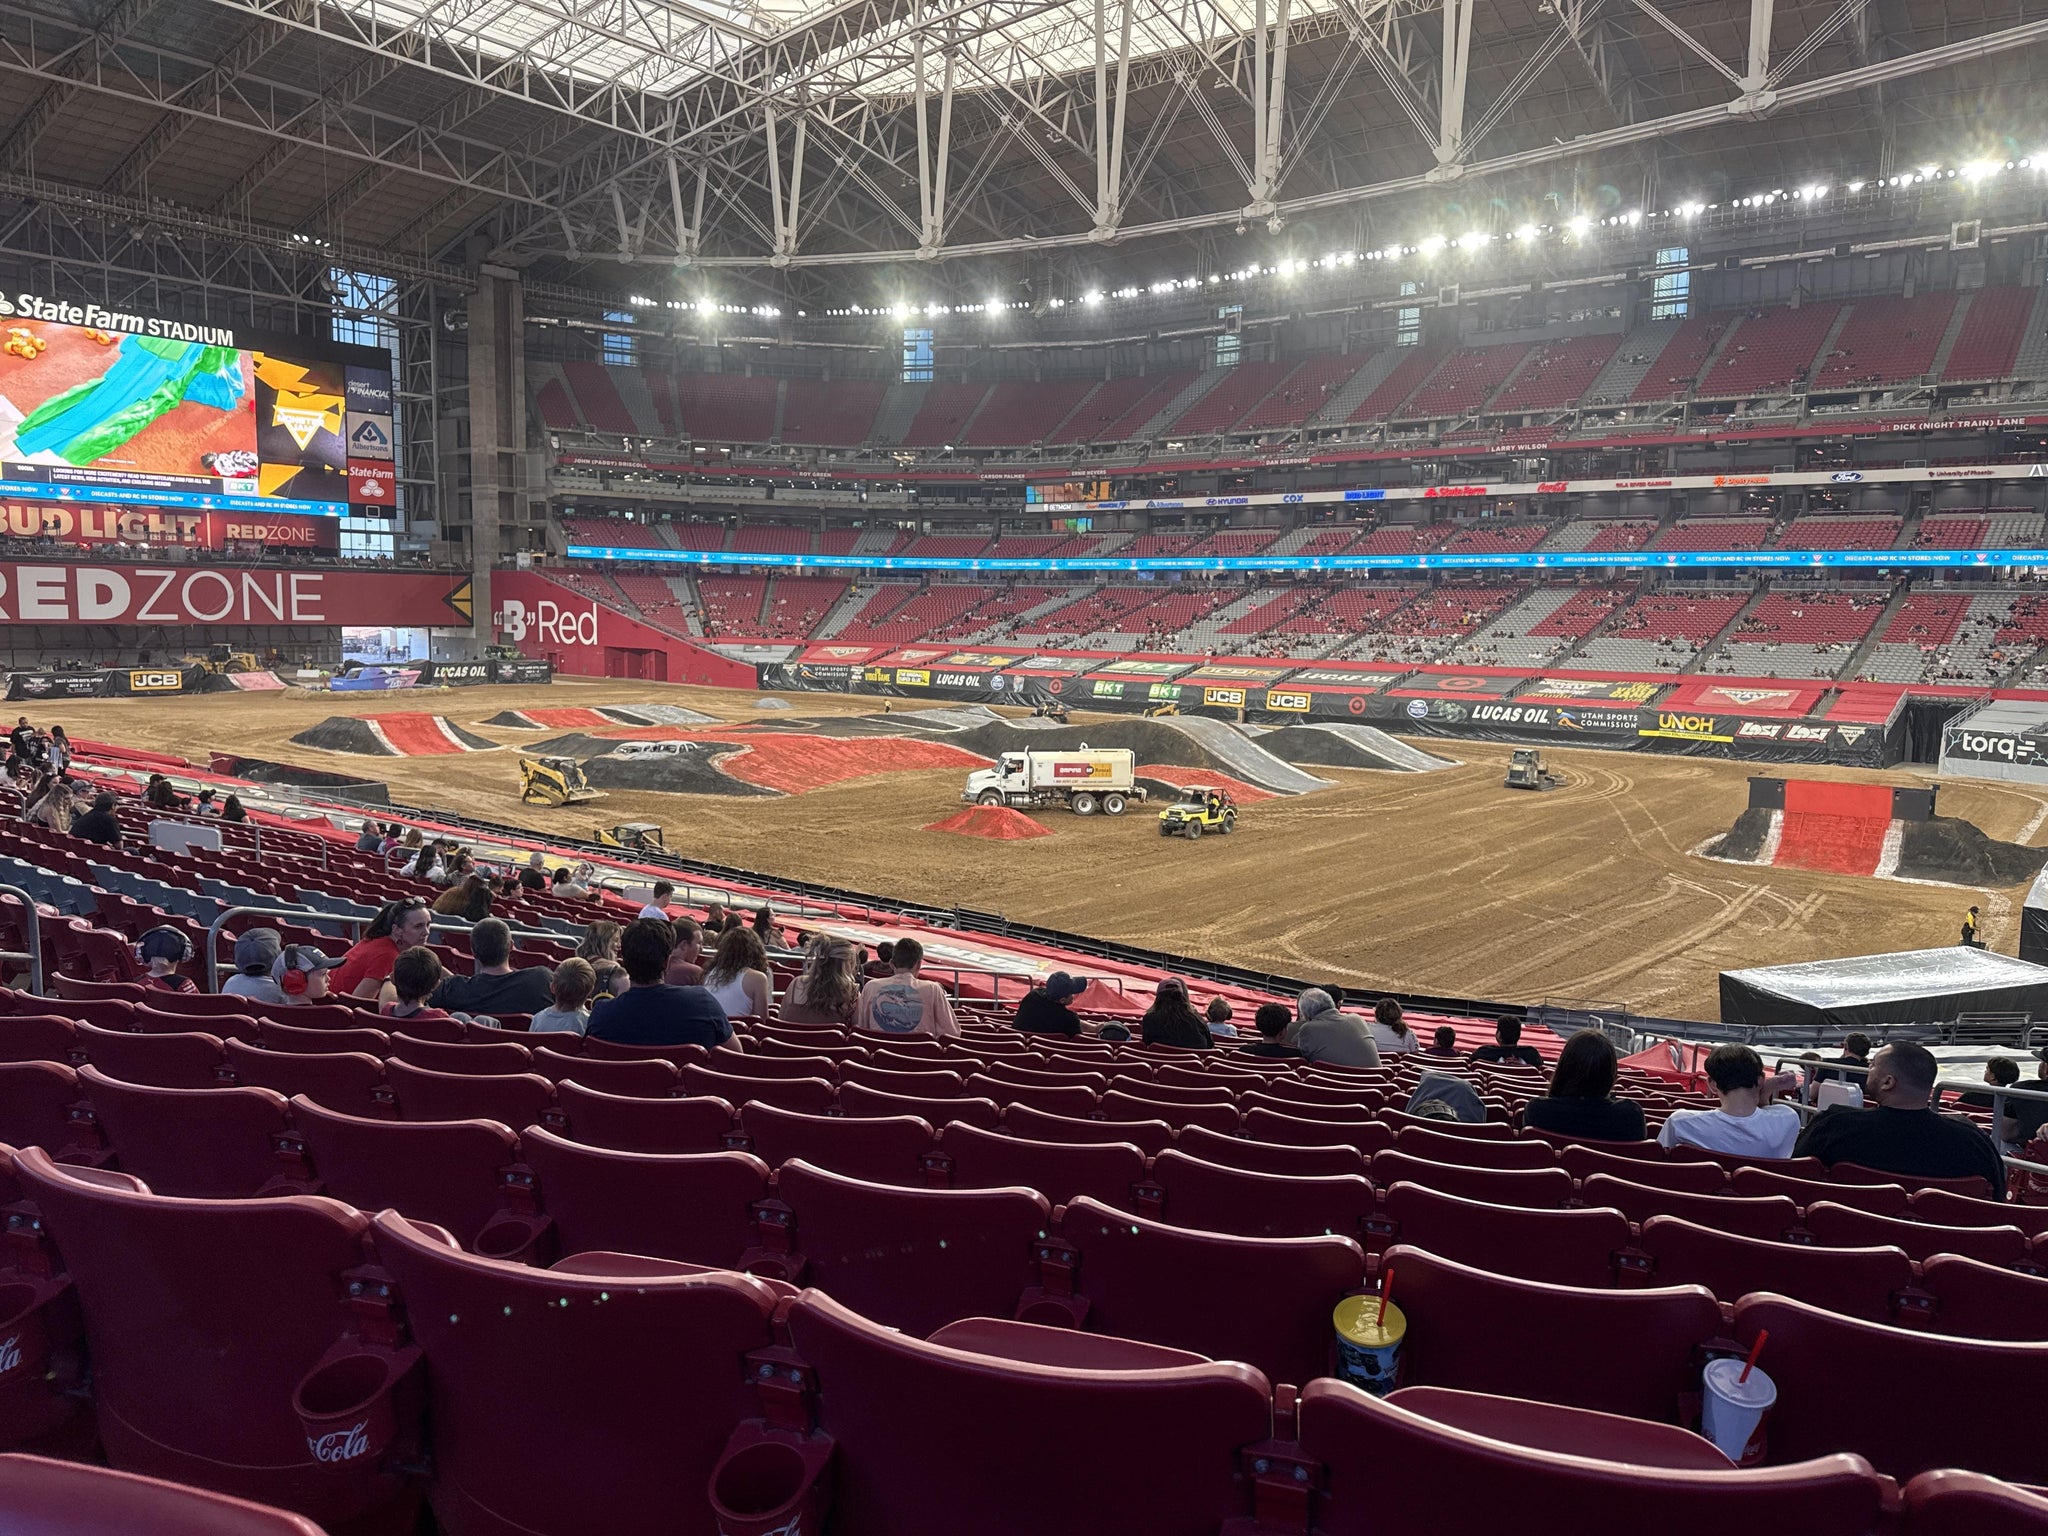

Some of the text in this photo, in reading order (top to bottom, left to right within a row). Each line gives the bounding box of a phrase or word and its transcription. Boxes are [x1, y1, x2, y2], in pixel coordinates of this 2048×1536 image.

[147, 317, 234, 347] STADIUM
[1893, 423, 1916, 431] DICK
[1919, 421, 1955, 430] (NIGHT
[1957, 420, 1994, 428] TRAIN)
[1997, 418, 2026, 426] LANE
[351, 441, 388, 453] Albertsons
[1491, 443, 1548, 453] LARRY WILSON
[1217, 497, 1249, 505] HYUNDAI
[1283, 494, 1304, 503] COX
[81, 506, 201, 541] LIGHT
[226, 523, 317, 542] REDZONE
[0, 565, 325, 621] EDZONE
[538, 600, 598, 646] Red
[433, 665, 468, 678] LUCAS
[469, 665, 487, 677] OIL
[134, 674, 178, 687] JCB
[936, 673, 965, 687] LUCAS
[966, 675, 981, 687] OIL
[1095, 682, 1124, 694] BKT
[1149, 684, 1181, 698] BKT
[1207, 691, 1242, 703] JCB
[1270, 695, 1307, 708] JCB
[1471, 704, 1548, 724] LUCAS OIL
[1581, 712, 1639, 722] UTAH SPORTS
[1581, 719, 1638, 729] COMMISSION
[1658, 713, 1714, 733] UNOH
